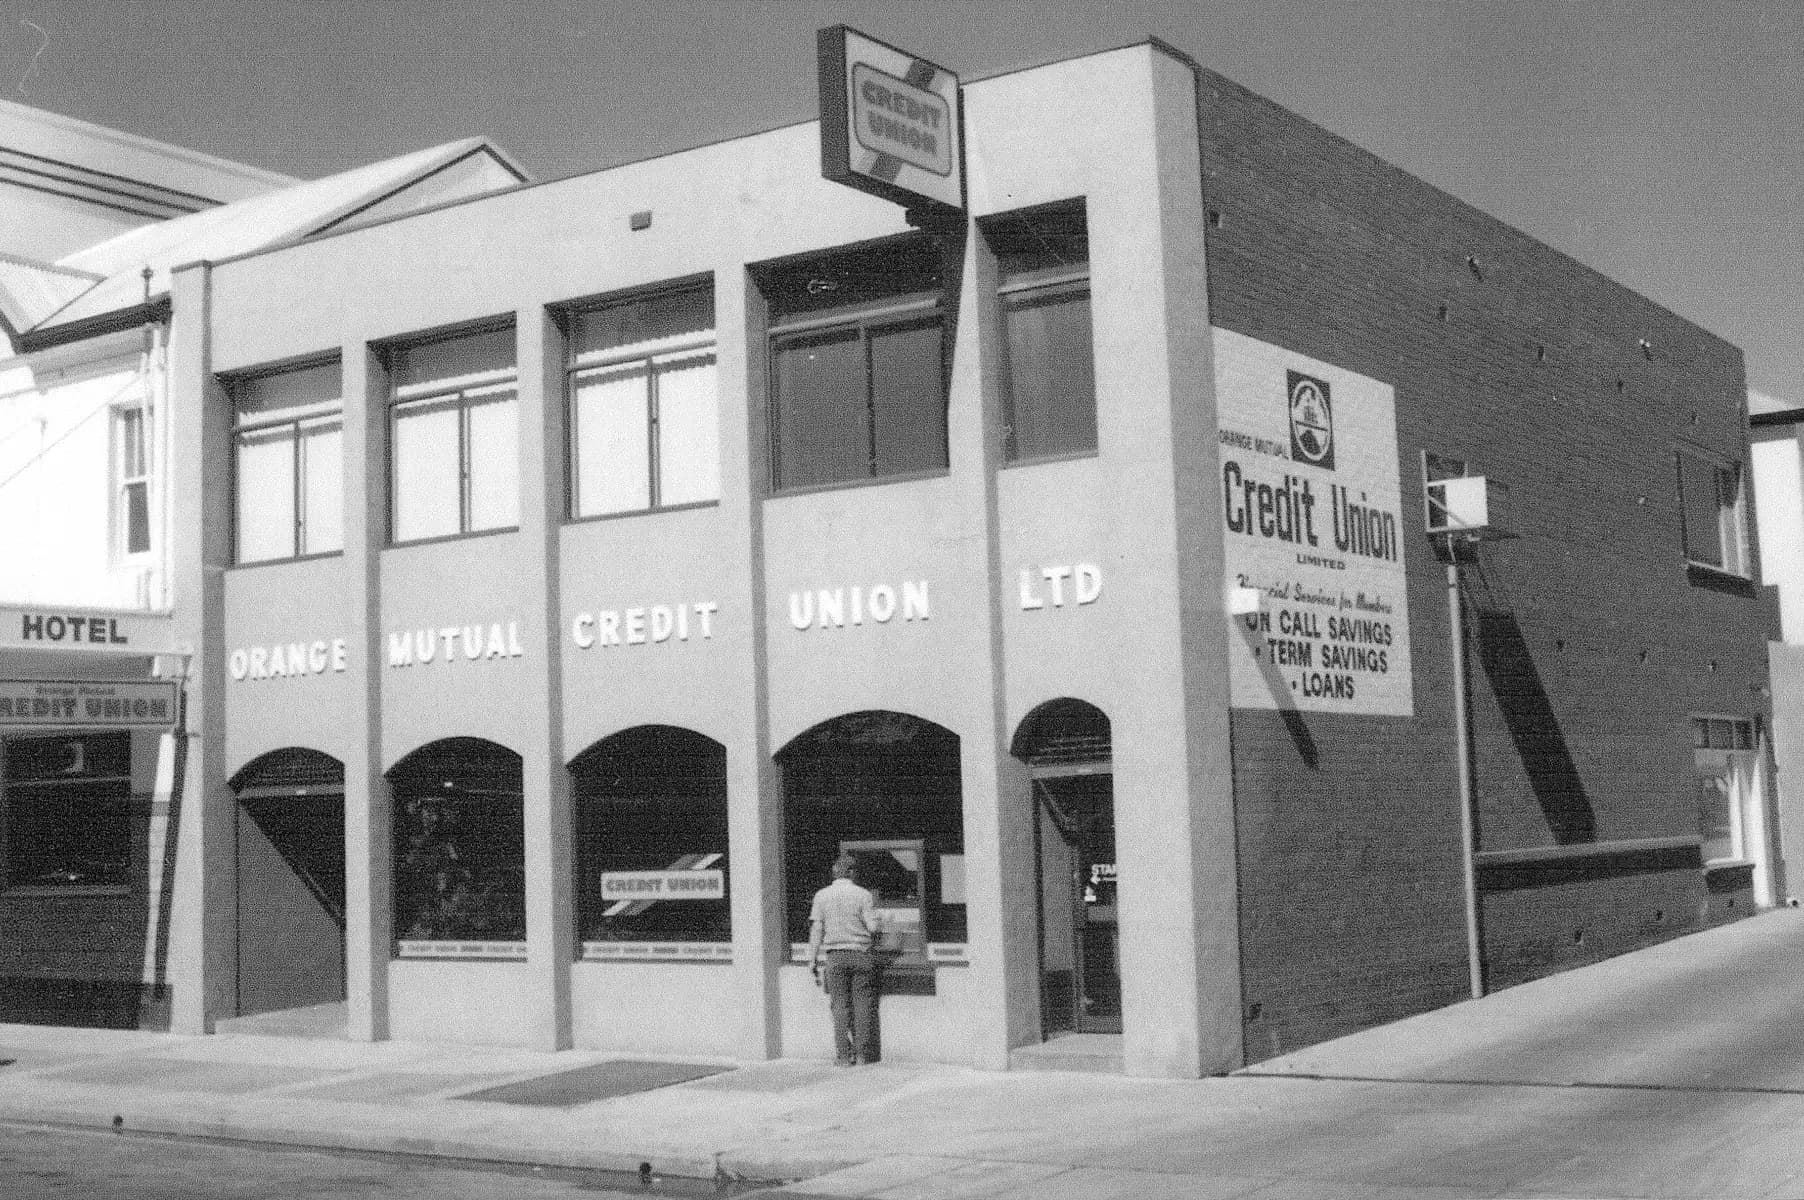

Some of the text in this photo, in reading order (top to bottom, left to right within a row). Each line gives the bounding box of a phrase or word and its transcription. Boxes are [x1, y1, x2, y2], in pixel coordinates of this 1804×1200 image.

[861, 79, 941, 129] CREDIT
[867, 110, 938, 155] UNION
[1219, 429, 1290, 461] ORANGE MUTUAL
[1224, 460, 1397, 563] Credit Union
[1296, 553, 1346, 571] LIMITED
[1293, 582, 1336, 606] Services
[22, 615, 128, 645] HOTEL
[229, 563, 1103, 681] ORANGE MUTUAL CREDIT UNION LTD
[1245, 609, 1393, 646] ON CALL SAVINGS
[1267, 637, 1388, 674] TERM SAVINGS
[1302, 671, 1355, 700] LOANS
[85, 698, 168, 718] UNION
[605, 877, 719, 892] CREDIT UNION
